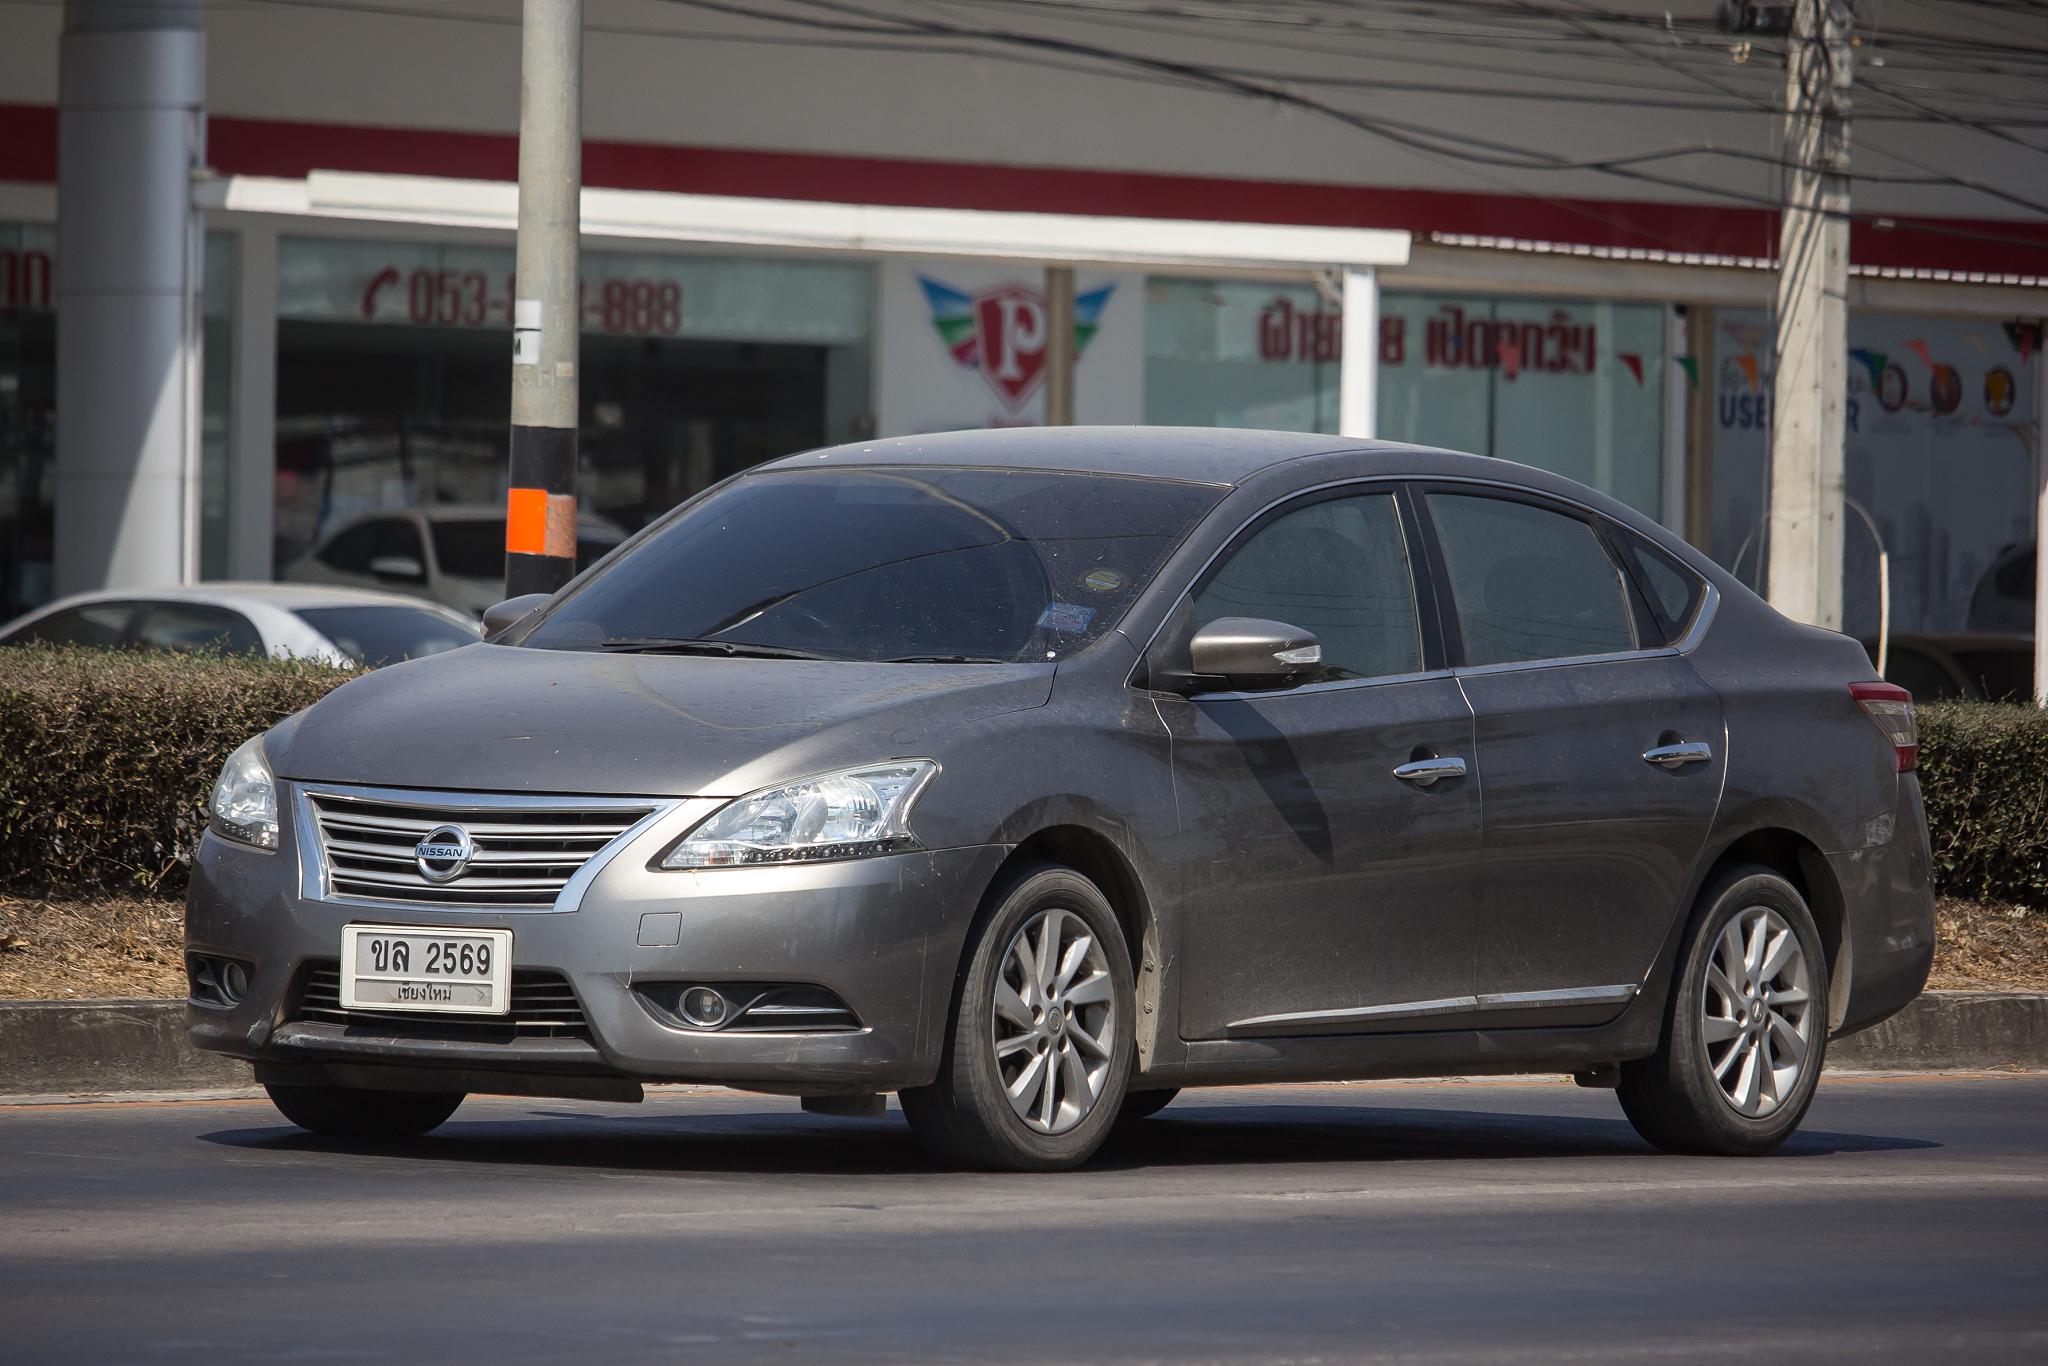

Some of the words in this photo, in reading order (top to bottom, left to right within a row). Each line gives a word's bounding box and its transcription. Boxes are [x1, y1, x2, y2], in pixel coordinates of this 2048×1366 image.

[409, 268, 682, 335] 053--888
[1719, 394, 1774, 431] USE
[418, 847, 463, 857] NISSAN
[371, 939, 410, 973] ขล
[425, 942, 491, 975] 2569
[397, 982, 453, 1001] เชียงใหม่
